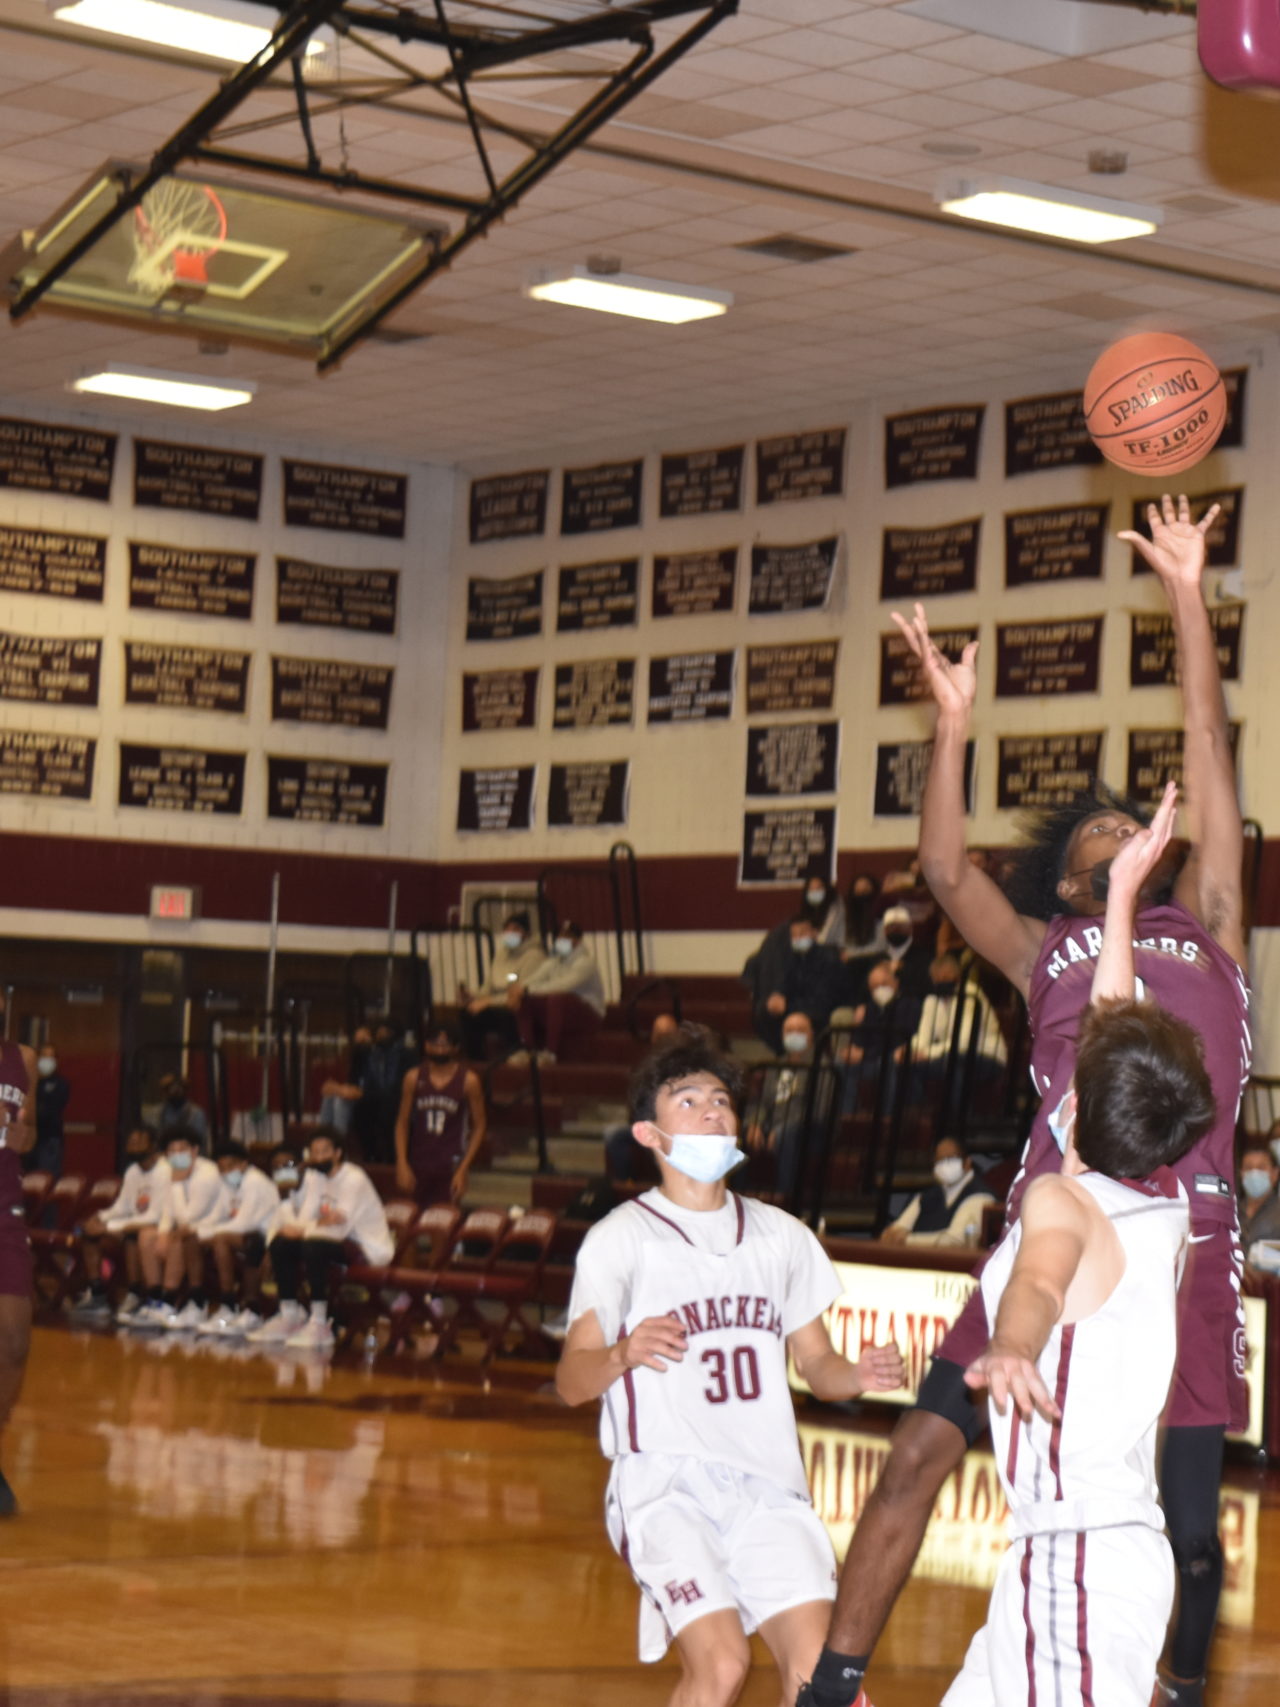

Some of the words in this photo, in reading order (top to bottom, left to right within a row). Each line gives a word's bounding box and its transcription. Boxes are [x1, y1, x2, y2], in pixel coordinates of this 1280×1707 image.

[1107, 369, 1201, 427] SPALDING
[893, 412, 977, 437] SOUTHAMPTON
[1123, 409, 1210, 457] TF-1000
[0, 425, 106, 454] OUTHAMPTON
[145, 446, 254, 473] SOUTHAMPTON
[293, 466, 398, 493] SOUTHAMPTON
[1013, 512, 1099, 535] SOUTHAMPTON
[890, 528, 973, 550] SOUTHAMPTON
[139, 547, 247, 573] SOUTHAMPTON
[286, 564, 389, 590] SOUTHAMPTON
[1005, 621, 1095, 647] SOUTHAMPTON
[131, 644, 243, 669] SOUTHAMPTON
[751, 647, 834, 667] SOUTHAMPTON
[279, 661, 387, 684] SOUTHAMPTON
[1007, 773, 1032, 792] GOLF
[1038, 770, 1089, 791] CHAMPIONS
[1047, 926, 1200, 979] MARERS
[701, 1345, 761, 1403] 30
[665, 1577, 704, 1606] EH
